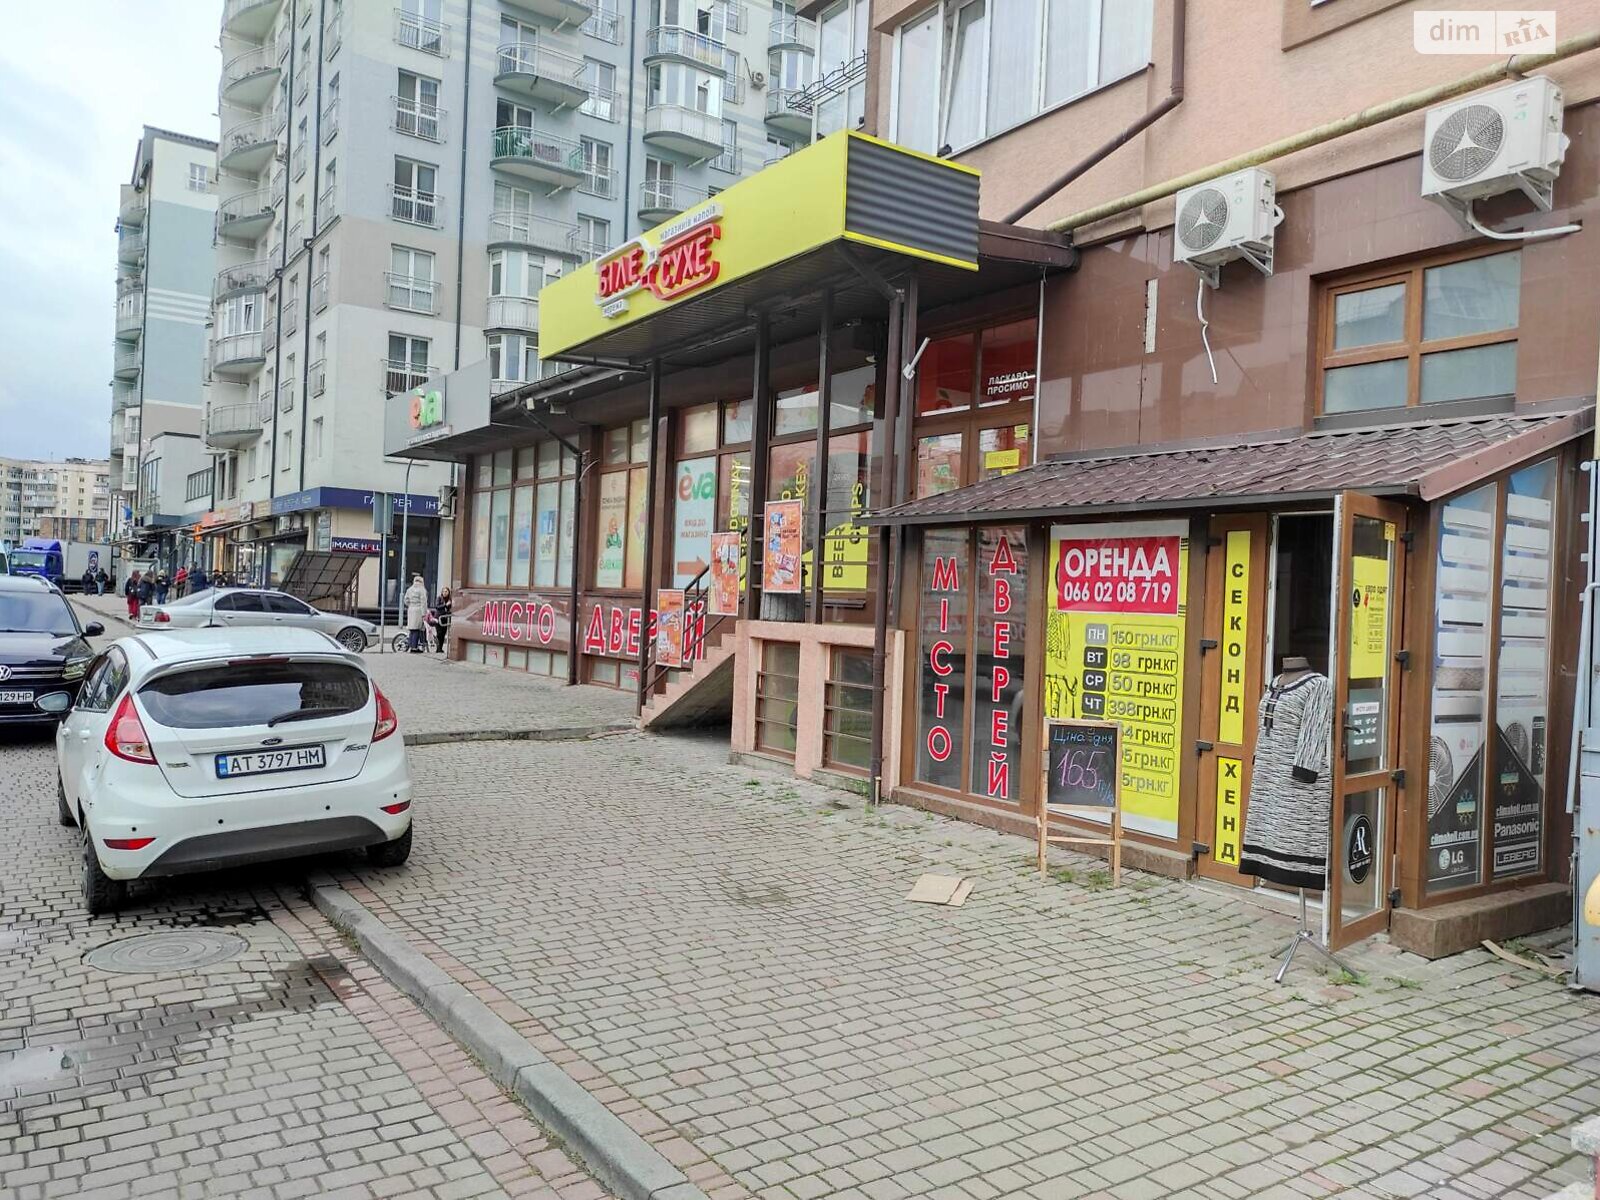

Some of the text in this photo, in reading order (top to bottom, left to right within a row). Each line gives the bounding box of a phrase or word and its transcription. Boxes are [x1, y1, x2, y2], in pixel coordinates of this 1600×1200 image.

[598, 248, 644, 297] БІЛЕ
[662, 235, 714, 289] СУХЕ
[987, 381, 1030, 396] ПРОСИМО
[988, 370, 1029, 386] ЛАСКАВО
[1064, 547, 1172, 581] ОРЕНДА
[1064, 581, 1172, 604] 066 02 08 719
[482, 600, 705, 662] МІСТО ДВЕРЙ
[1087, 629, 1106, 641] ПН
[1225, 563, 1244, 713] СЕКОНД
[927, 557, 960, 762] МІСТО
[987, 535, 1017, 799] ДВЕРЕЙ
[1087, 652, 1104, 664] ВТ
[1085, 674, 1104, 686] СР
[1112, 675, 1133, 692] 50
[1085, 698, 1102, 706] ЧТ
[231, 749, 320, 772] AT 3797 HM
[1056, 749, 1106, 789] 165
[1221, 763, 1237, 861] ХЕНД
[1494, 818, 1540, 837] Panasonic
[1451, 849, 1464, 864] LG
